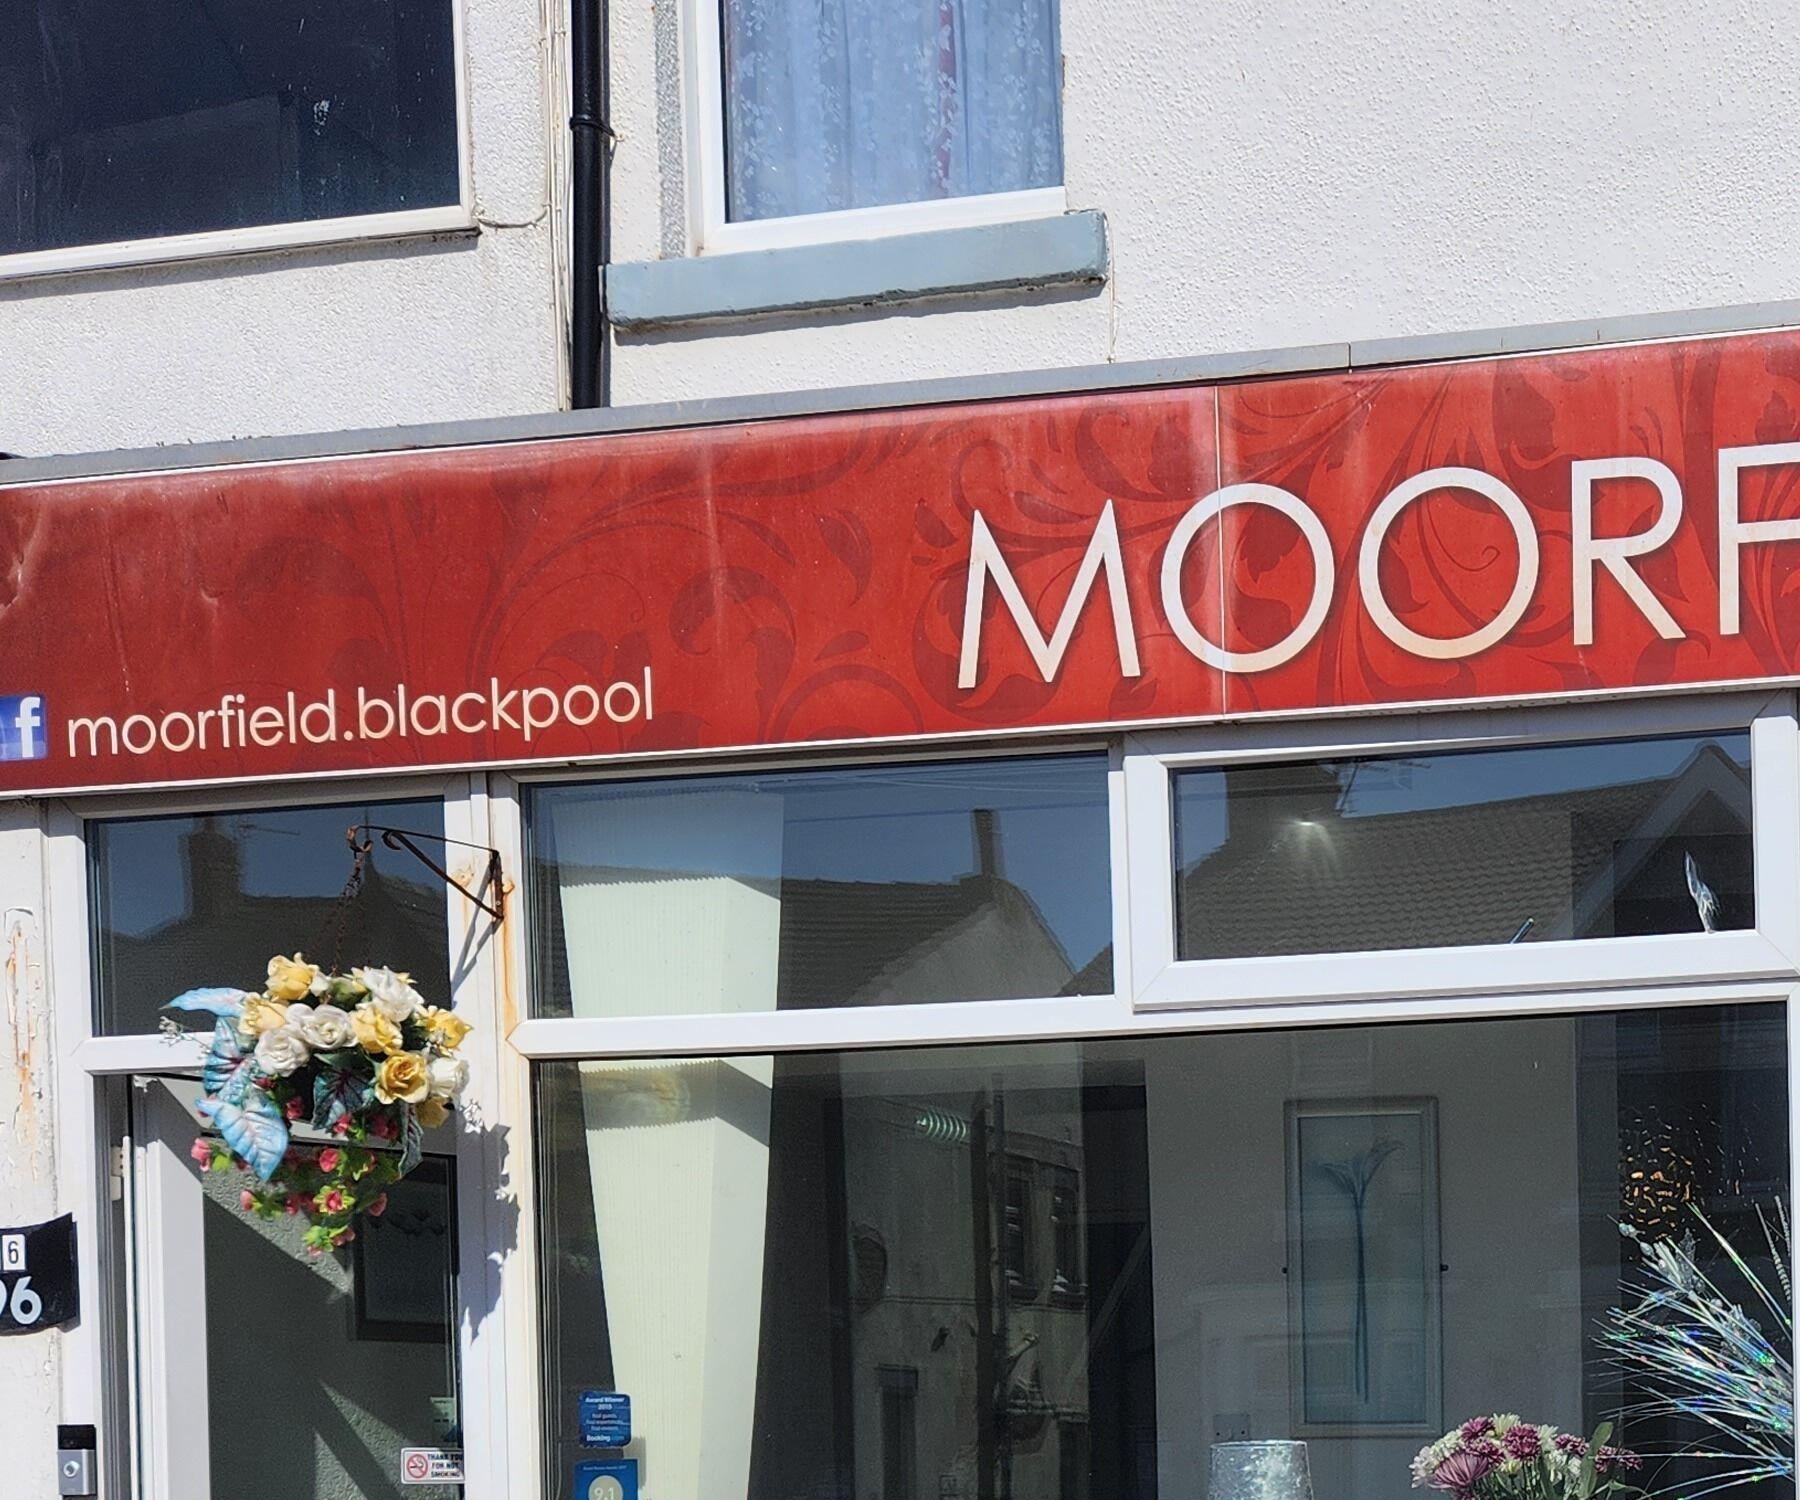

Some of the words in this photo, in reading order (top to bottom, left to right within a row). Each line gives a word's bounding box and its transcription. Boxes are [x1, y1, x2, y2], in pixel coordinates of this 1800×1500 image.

[66, 666, 654, 758] moorfield.blackpool
[7, 1240, 20, 1264] 6
[0, 1275, 43, 1325] 6
